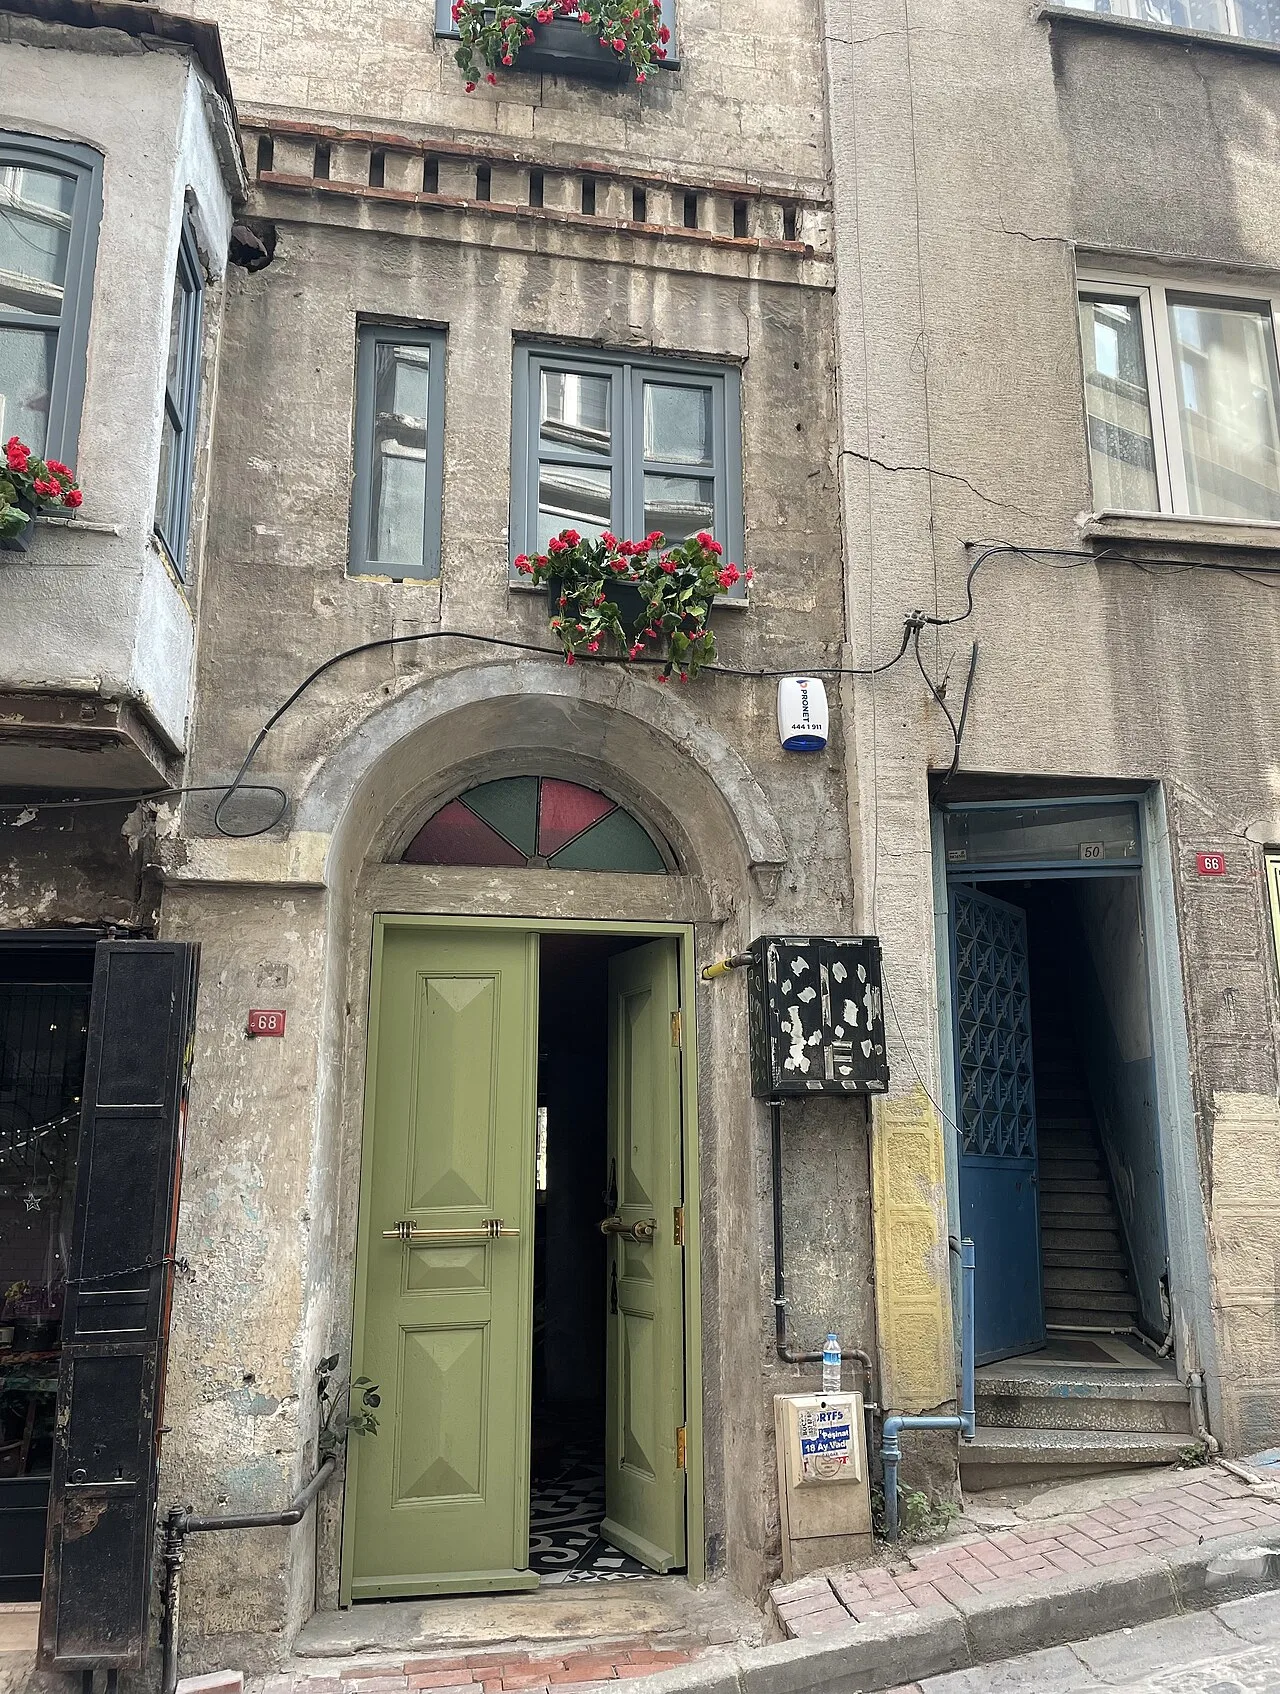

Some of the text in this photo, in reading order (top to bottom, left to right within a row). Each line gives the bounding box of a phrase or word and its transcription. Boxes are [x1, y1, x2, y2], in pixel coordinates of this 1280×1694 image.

[800, 689, 810, 723] PRONET
[1084, 846, 1100, 858] 50
[1204, 857, 1219, 870] 66
[258, 1015, 277, 1029] 68
[816, 1411, 844, 1422] RTFS
[805, 1444, 815, 1452] 18
[817, 1443, 828, 1452] Ay
